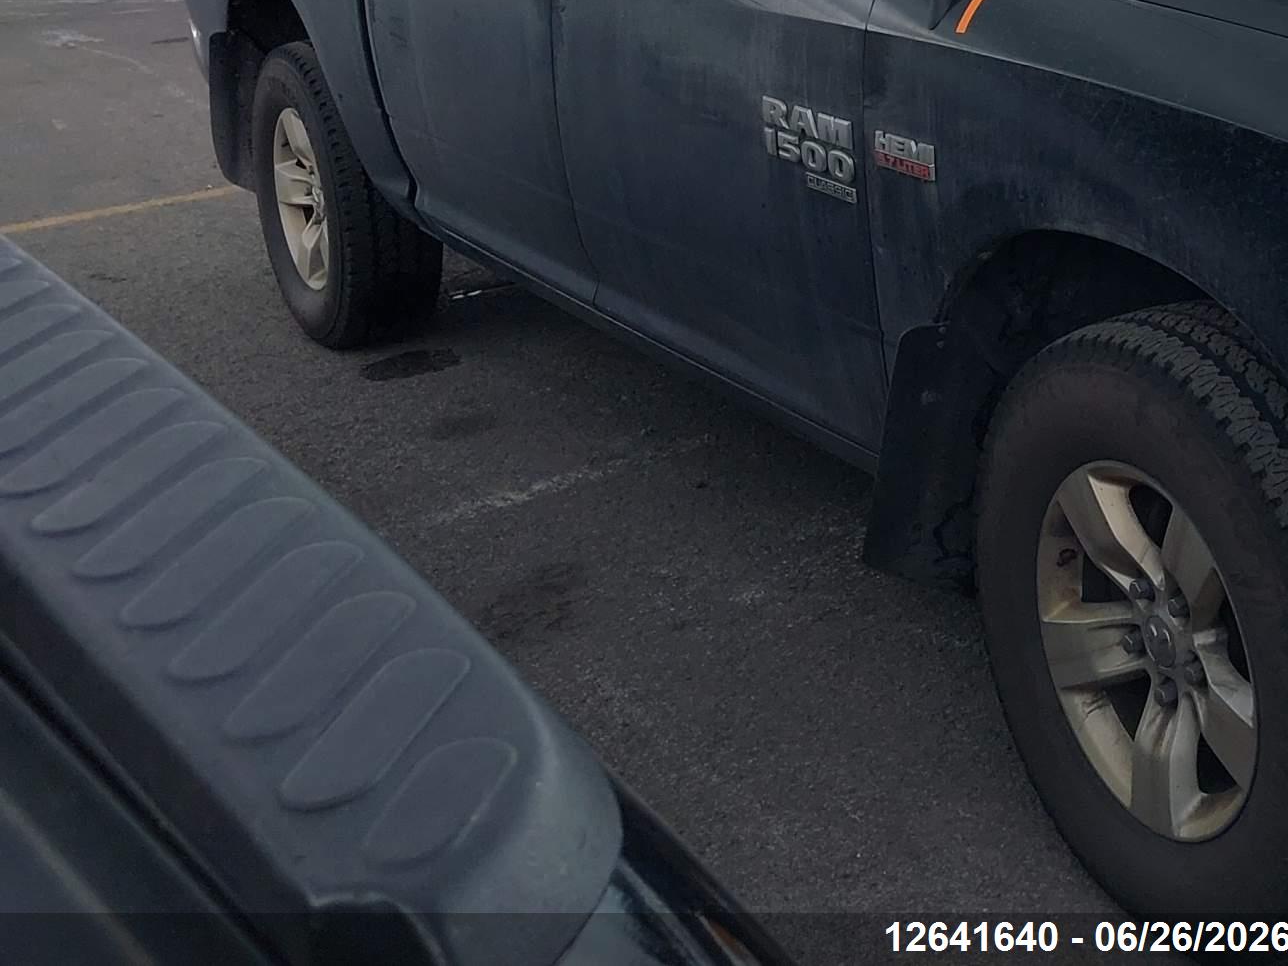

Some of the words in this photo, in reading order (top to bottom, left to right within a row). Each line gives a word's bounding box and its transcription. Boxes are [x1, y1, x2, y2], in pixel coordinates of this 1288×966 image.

[762, 95, 852, 149] RAM
[874, 130, 935, 166] HEMI
[764, 127, 856, 183] 1500
